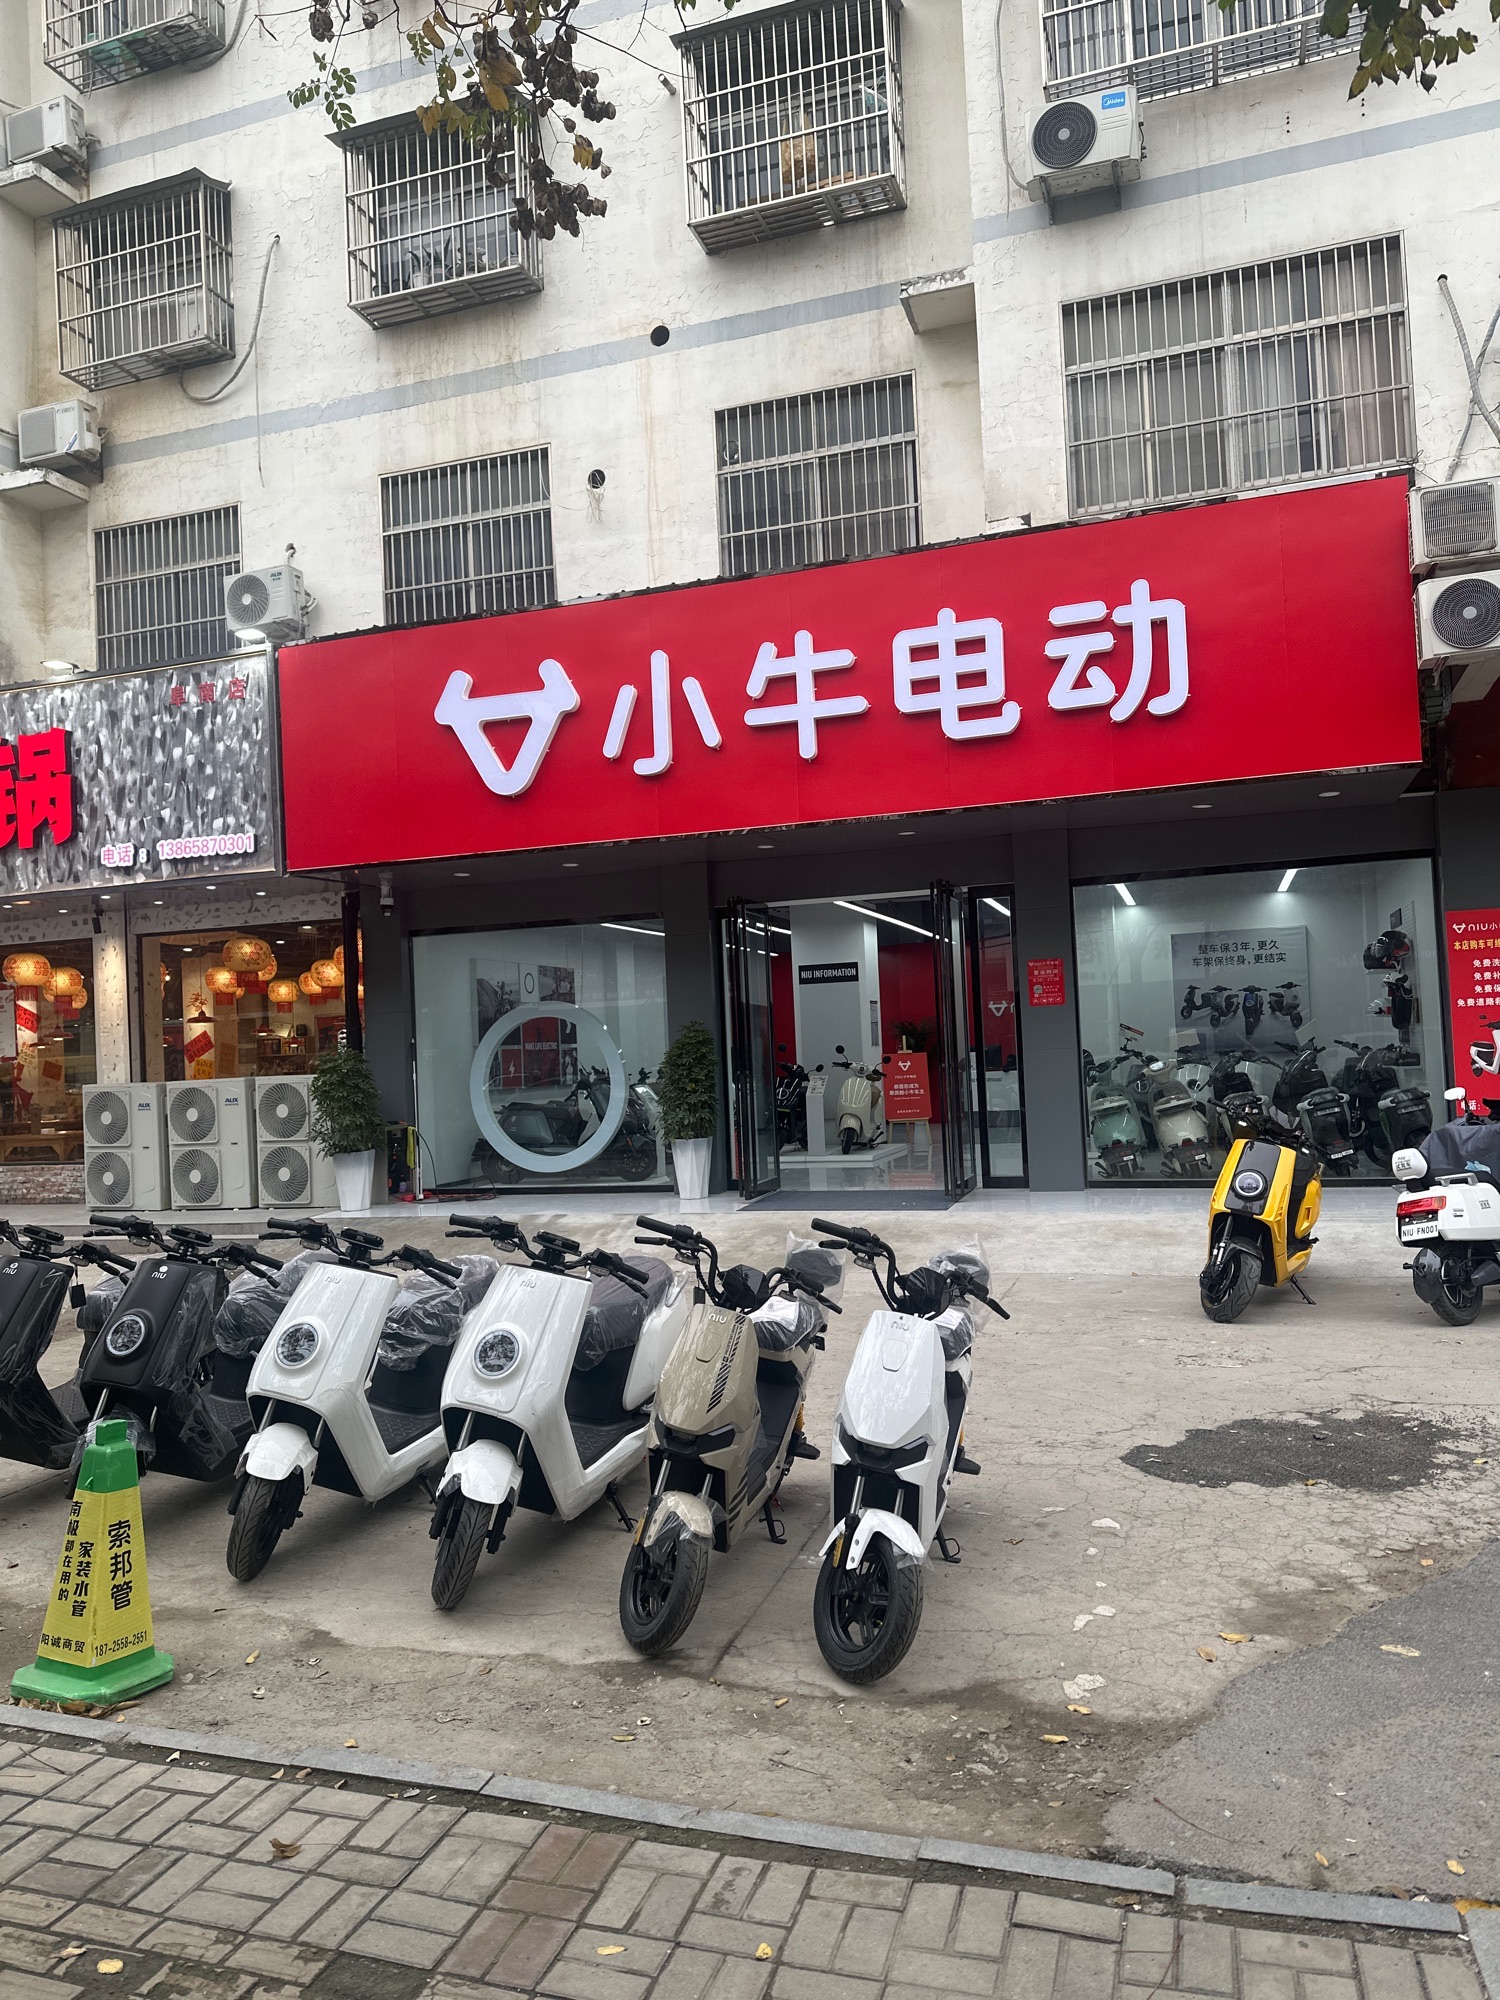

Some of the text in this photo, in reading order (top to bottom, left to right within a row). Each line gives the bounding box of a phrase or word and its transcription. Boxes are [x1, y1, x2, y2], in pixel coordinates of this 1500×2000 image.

[602, 579, 1190, 777] 小牛电动
[169, 678, 247, 707] 阜南店
[157, 833, 255, 861] 13865870301
[801, 967, 856, 979] NIU INFORMATION
[107, 1519, 133, 1611] 索邦管
[71, 1541, 94, 1618] 家装水管
[40, 1632, 86, 1654] 阳诚商贸
[95, 1630, 148, 1658] 187-2558-2551
